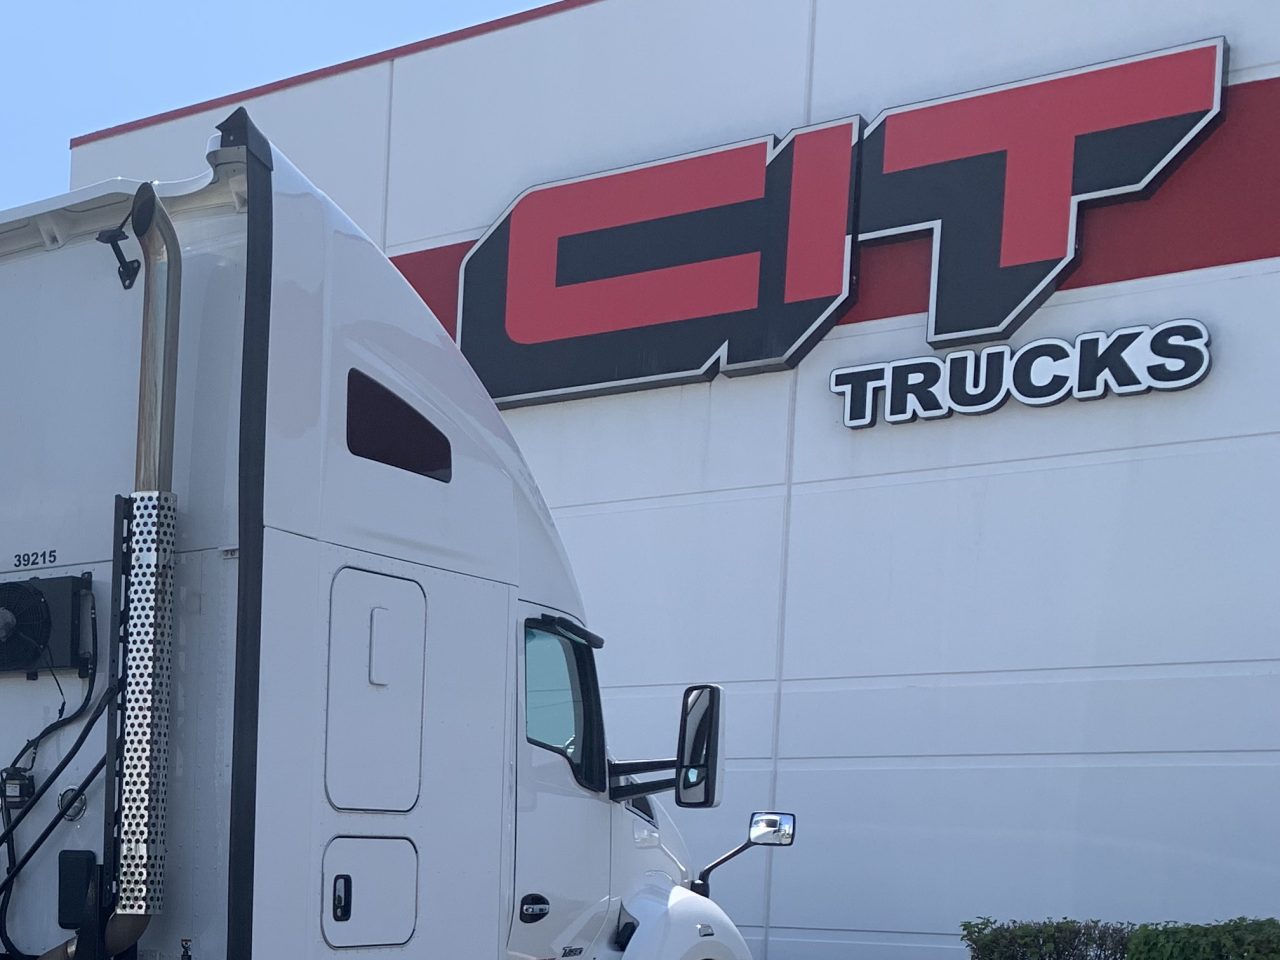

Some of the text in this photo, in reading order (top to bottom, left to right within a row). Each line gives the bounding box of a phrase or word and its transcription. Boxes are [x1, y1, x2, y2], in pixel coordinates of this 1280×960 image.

[480, 40, 1221, 380] CIT
[832, 320, 1210, 426] TRUCKS
[13, 549, 57, 568] 39215
